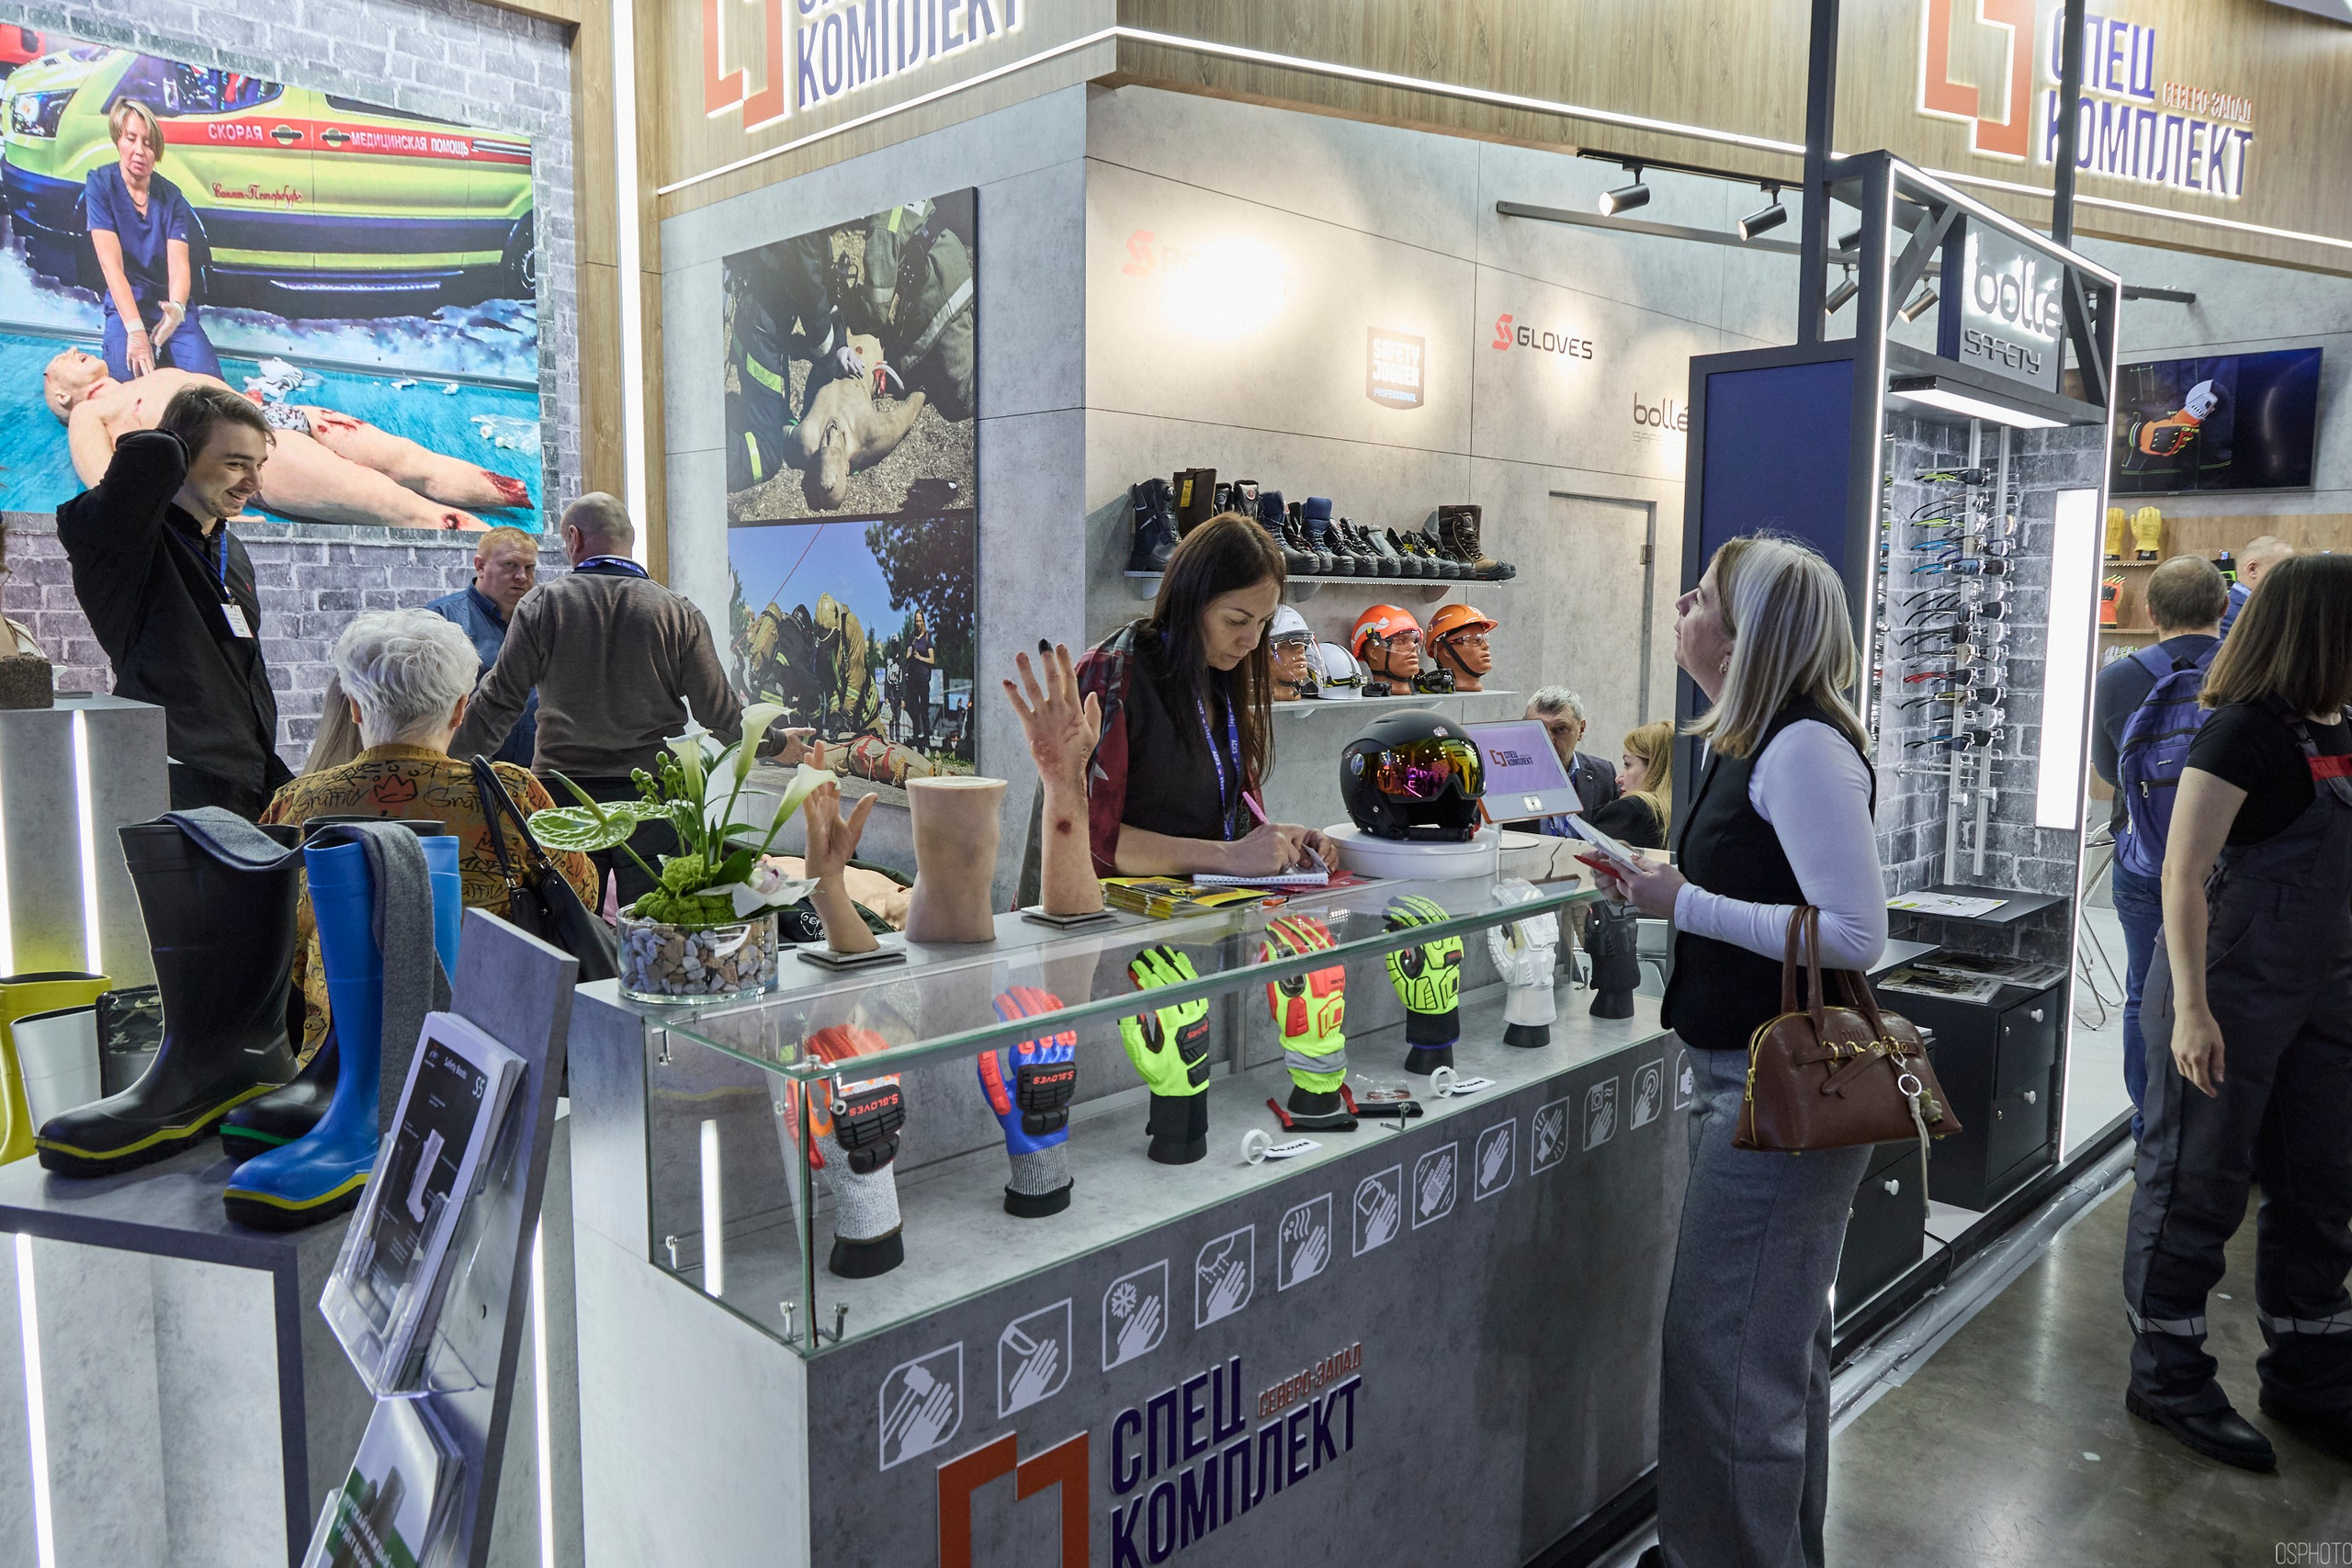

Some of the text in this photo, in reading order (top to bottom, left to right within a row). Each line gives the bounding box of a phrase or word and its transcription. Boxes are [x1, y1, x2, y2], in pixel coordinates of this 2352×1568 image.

[2162, 81, 2253, 124] СЕВЕРО-ЗАПАД
[208, 123, 469, 156] СКОРАЯ МЕДИЦИНСКАЯ ПОМОЩЬ
[1372, 337, 1420, 367] SAFETY
[1517, 325, 1593, 360] GLOVES
[1964, 328, 2041, 375] SAFETY
[1374, 387, 1418, 402] PROFESSIONAL
[471, 1076, 486, 1099] S5
[1032, 1070, 1075, 1085] S.GLOVES
[848, 1093, 899, 1118] S.GLOVES
[1258, 1341, 1363, 1420] СЕВЕРО-ЗАПАД
[1110, 1355, 1247, 1495] СПЕЦ
[1110, 1373, 1363, 1568] КОМПЛЕКТ
